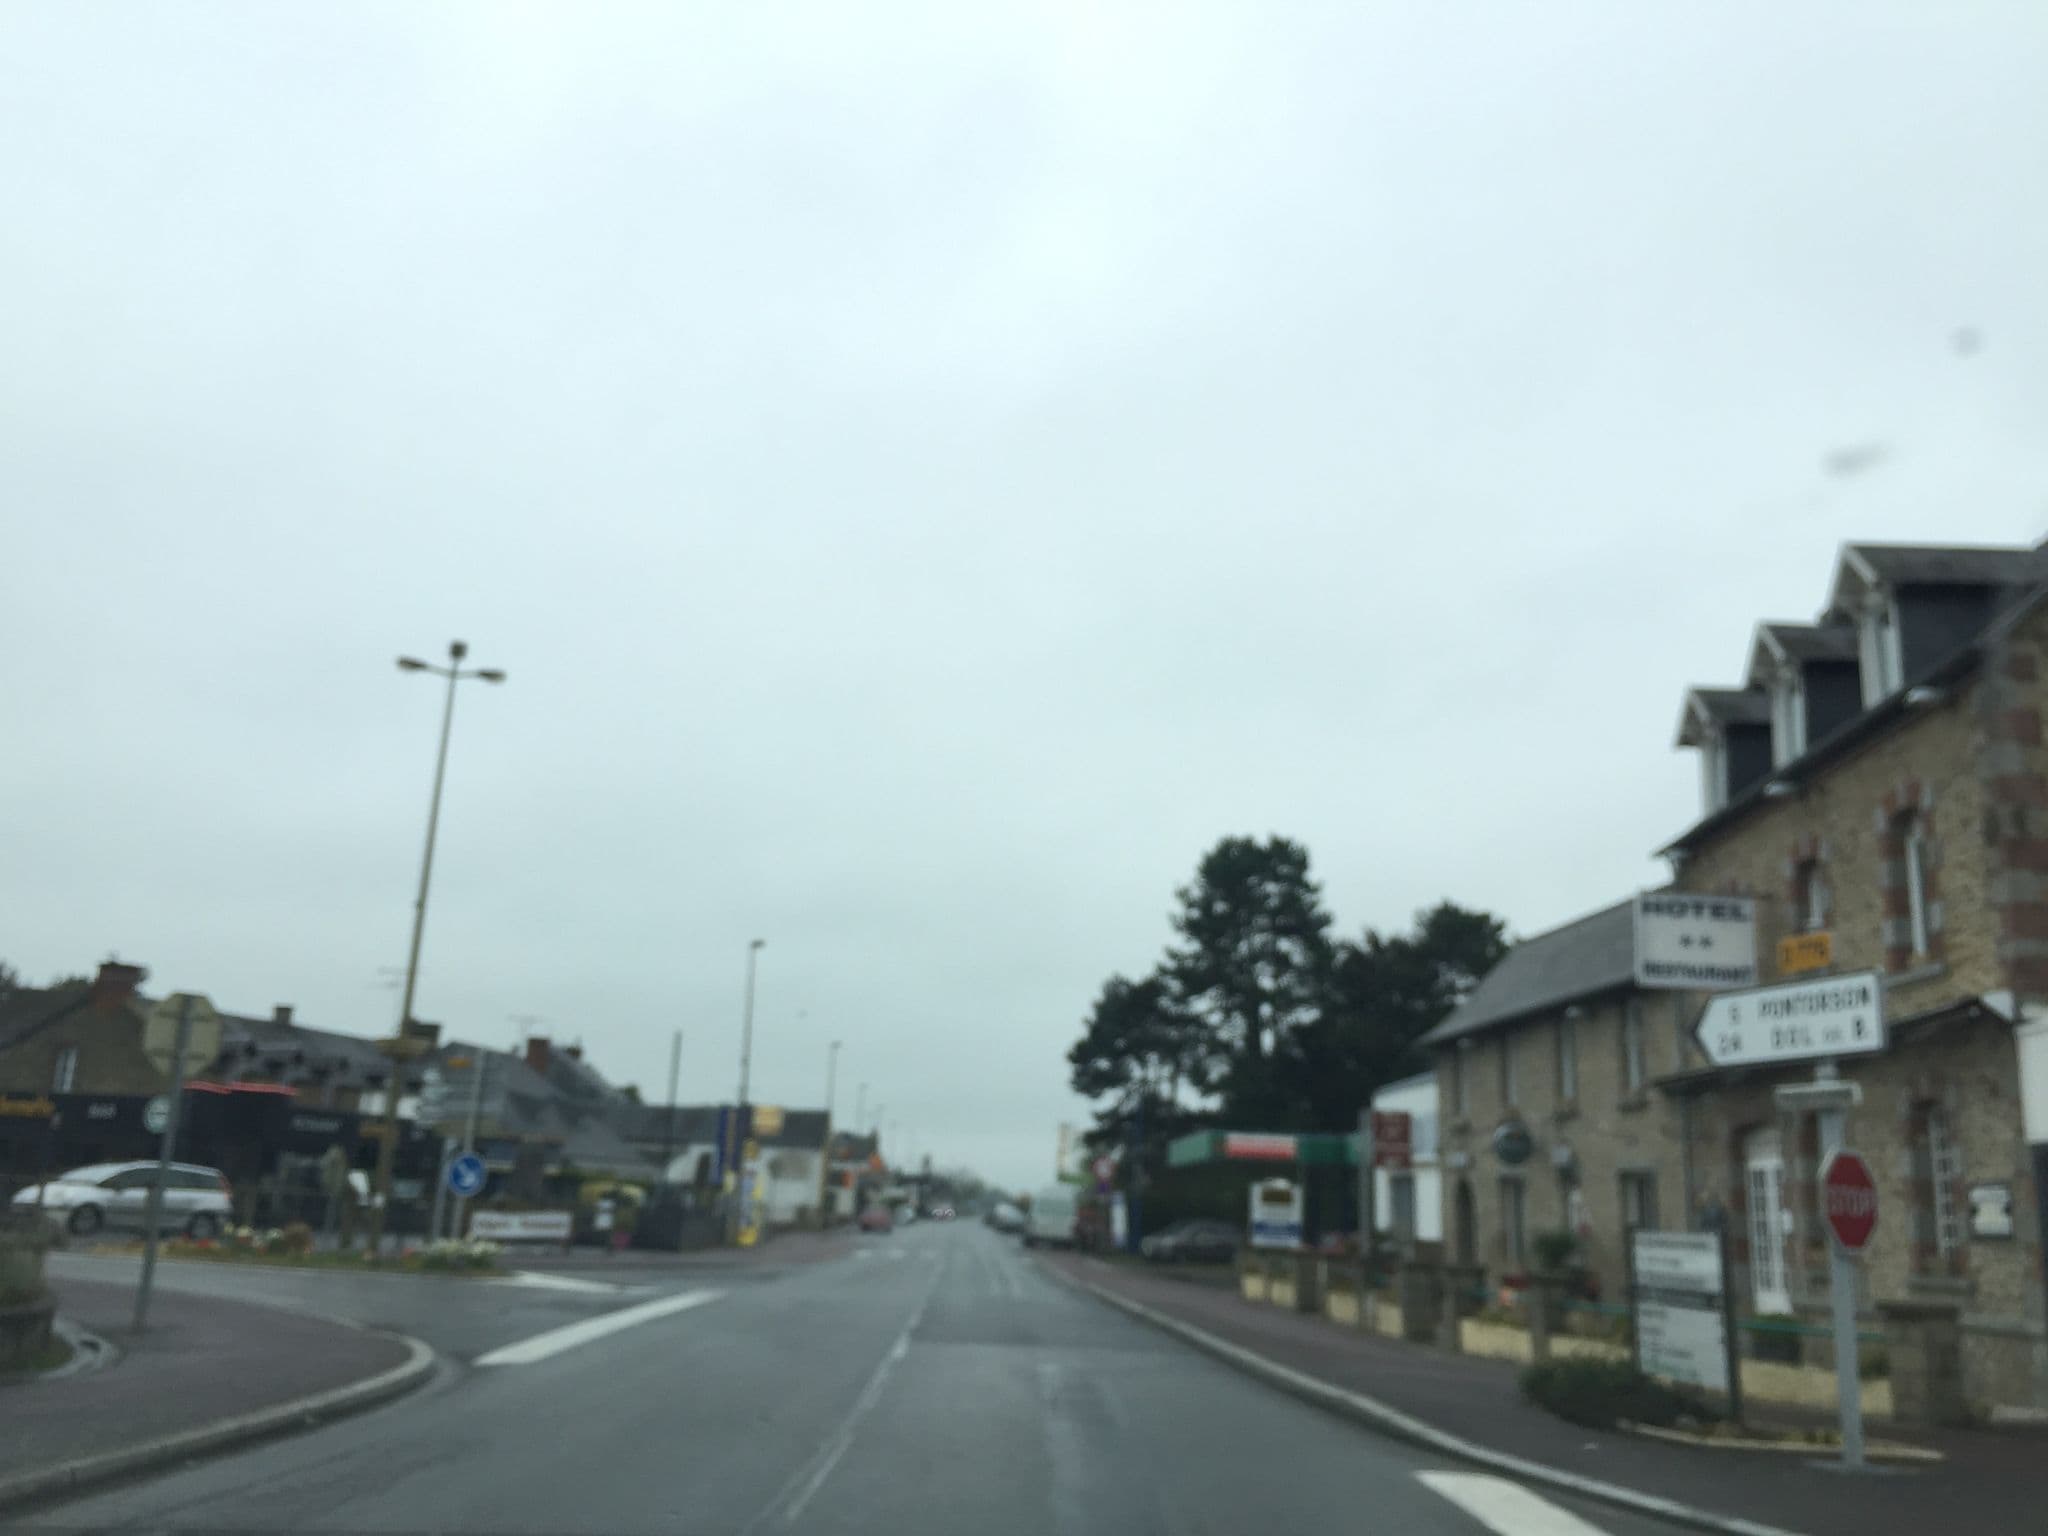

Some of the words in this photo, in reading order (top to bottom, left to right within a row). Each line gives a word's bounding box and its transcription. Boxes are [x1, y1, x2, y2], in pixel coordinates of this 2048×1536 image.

[1643, 901, 1747, 921] HOTEL
[1758, 985, 1869, 1019] PONTORSON
[1828, 1186, 1875, 1215] STOP
